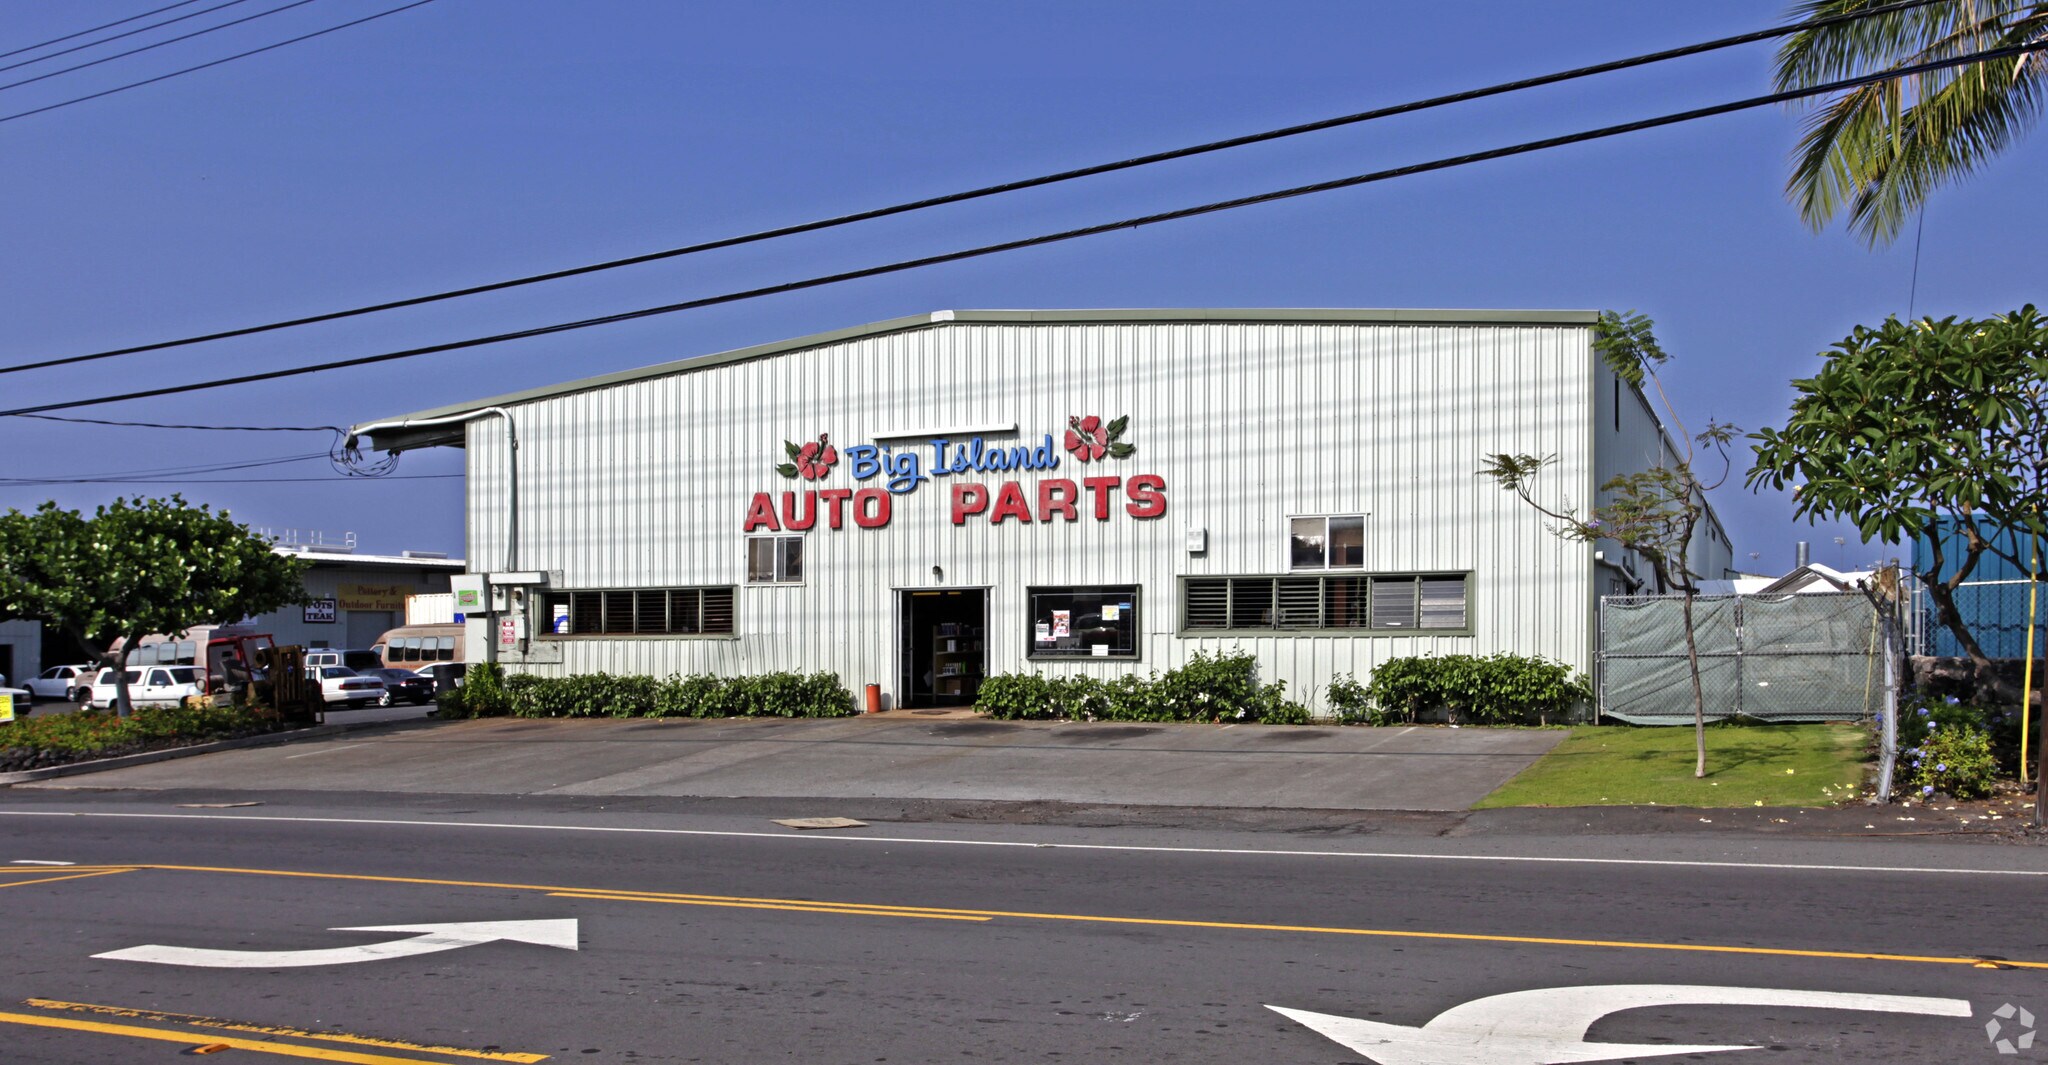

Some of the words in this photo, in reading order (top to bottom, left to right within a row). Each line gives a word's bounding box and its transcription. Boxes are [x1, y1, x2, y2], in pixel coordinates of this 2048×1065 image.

[844, 444, 929, 493] Big
[928, 434, 1060, 475] Island
[743, 487, 893, 532] AUTO
[951, 474, 1167, 524] PARTS
[357, 584, 388, 598] Pottery
[388, 585, 397, 596] &
[339, 599, 372, 609] Outdoor
[306, 612, 333, 620] TEAK
